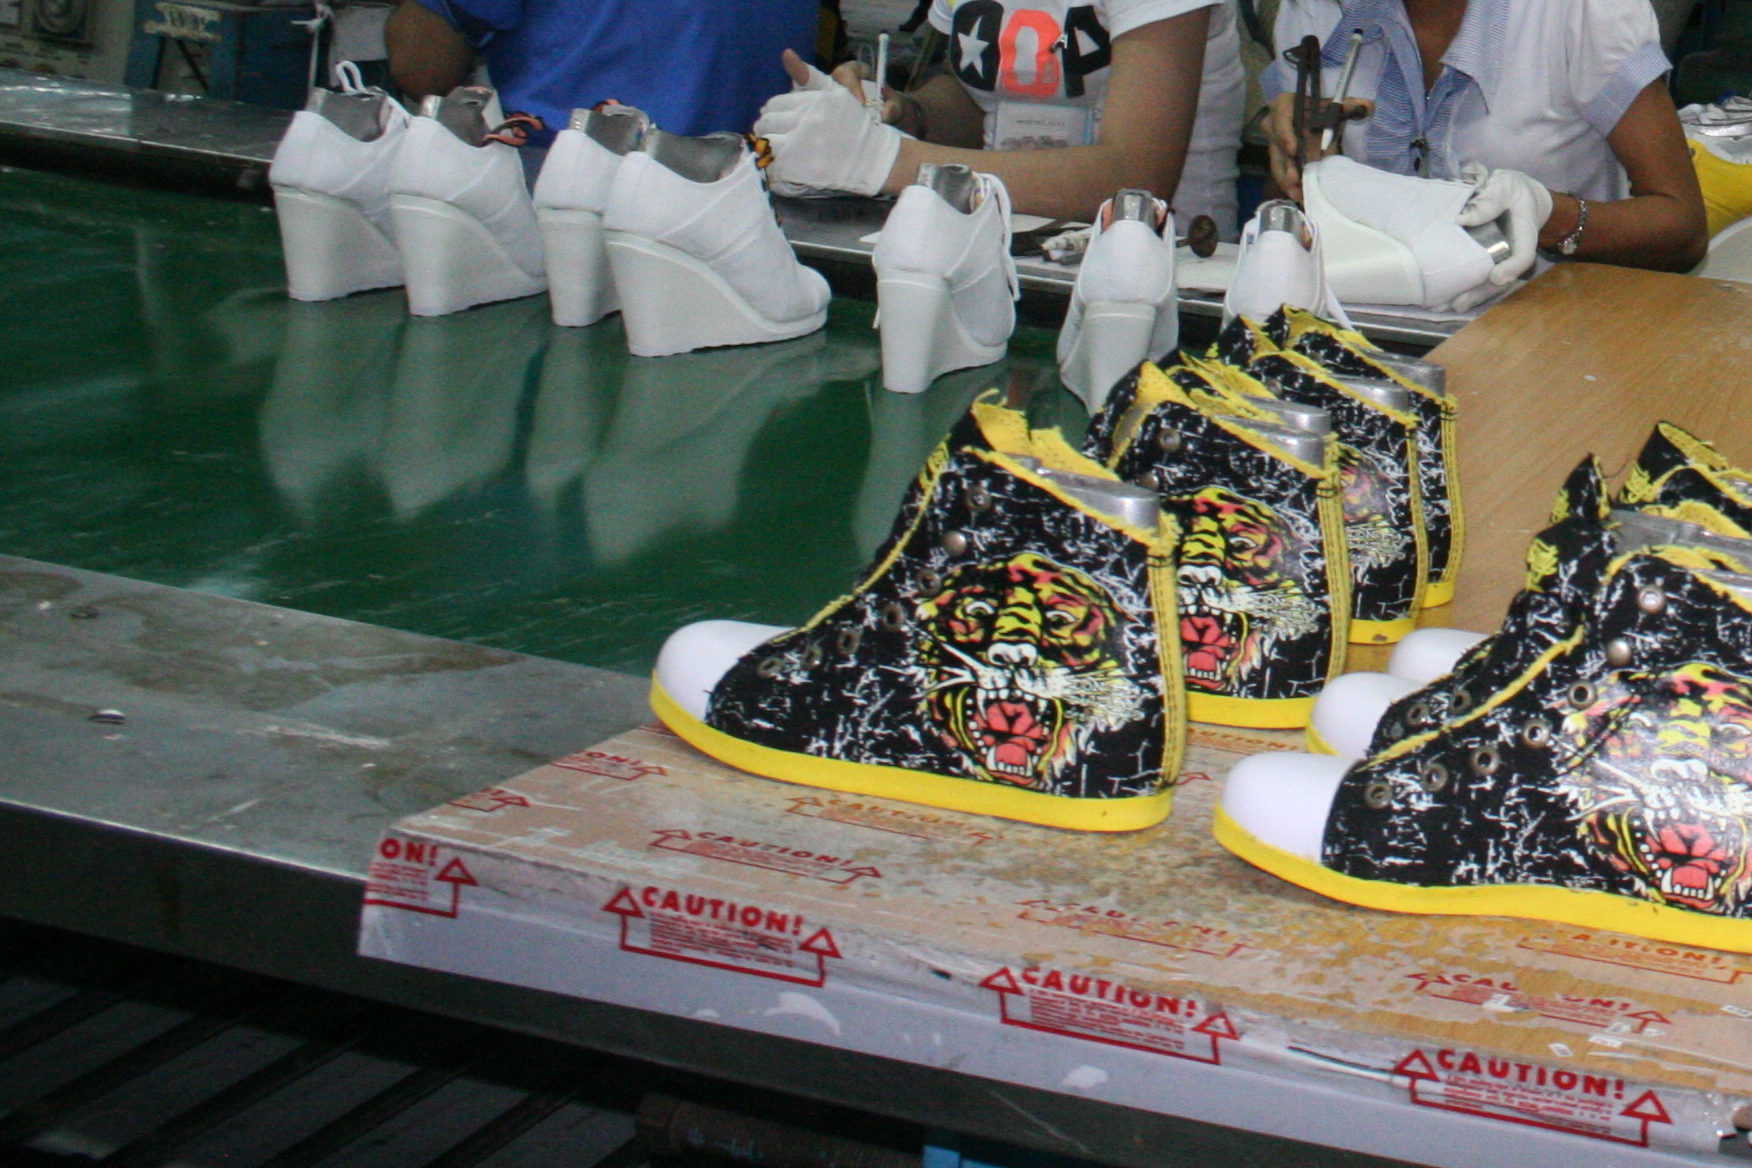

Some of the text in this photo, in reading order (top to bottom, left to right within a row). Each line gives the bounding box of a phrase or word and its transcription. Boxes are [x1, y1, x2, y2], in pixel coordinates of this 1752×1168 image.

[379, 838, 438, 867] ON!
[697, 831, 853, 868] CAUTION!
[641, 885, 804, 936] CAUTION!
[1021, 965, 1198, 1019] CAUTION!
[1437, 1048, 1625, 1100] CAUTION!
